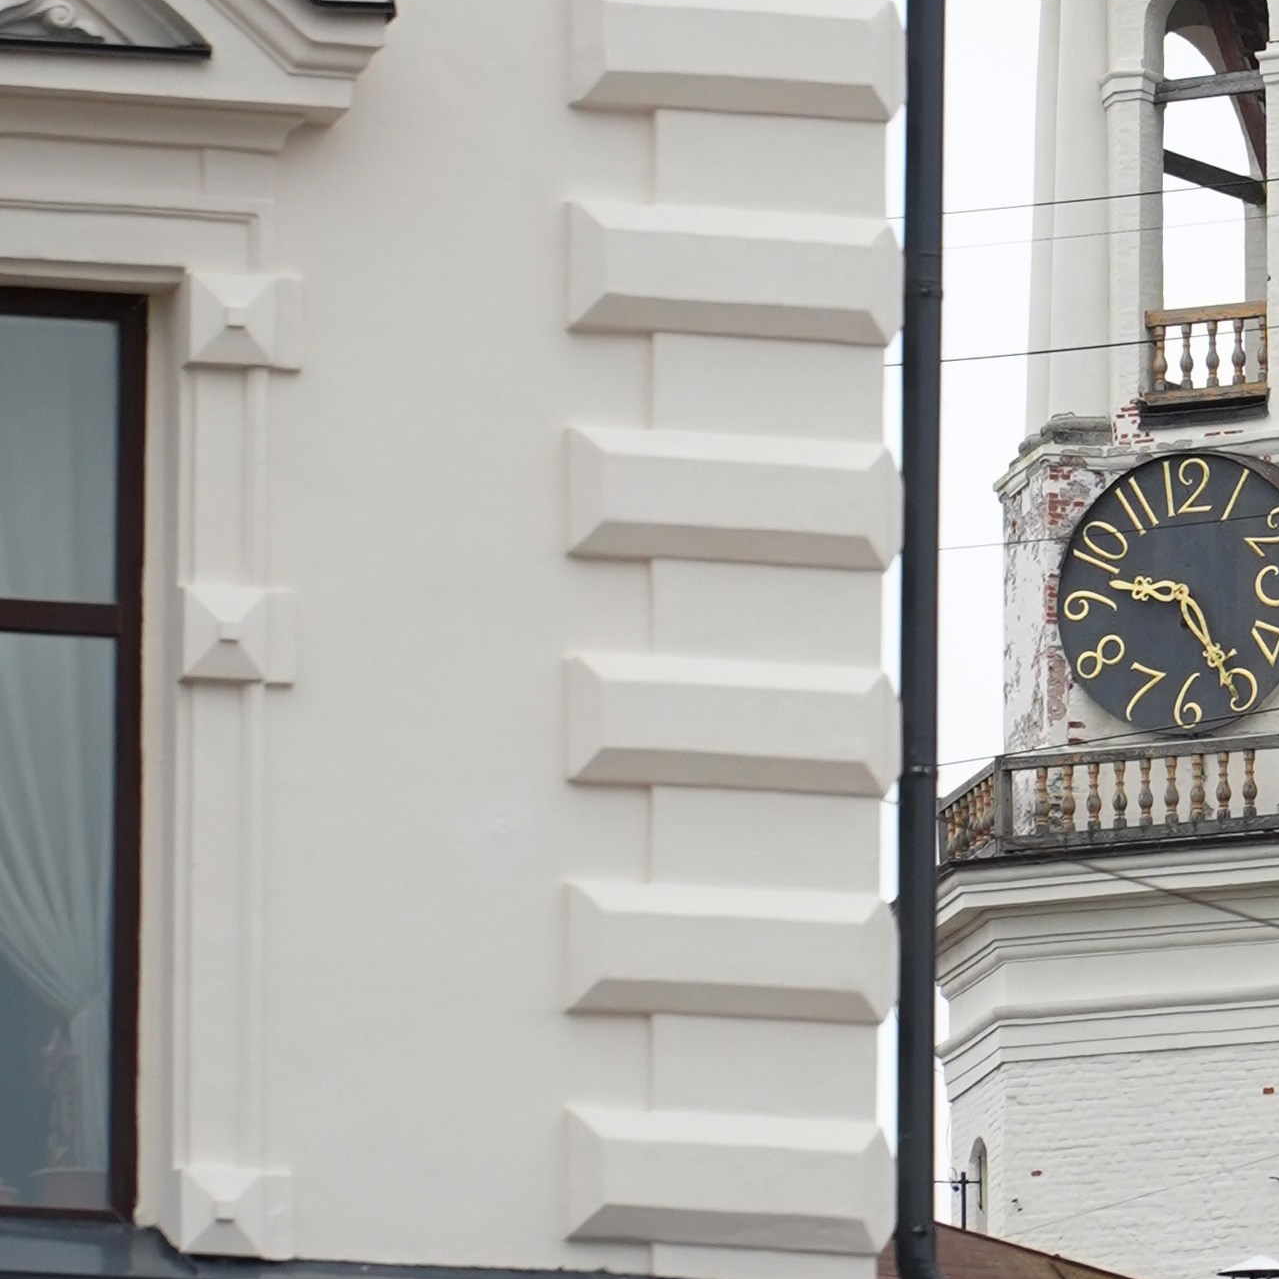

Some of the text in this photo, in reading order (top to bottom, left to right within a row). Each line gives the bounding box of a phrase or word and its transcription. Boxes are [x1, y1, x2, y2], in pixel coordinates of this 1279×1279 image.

[1115, 476, 1159, 536] 11
[1162, 457, 1212, 518] 12
[1220, 468, 1249, 521] 1
[1073, 521, 1128, 574] 10
[1064, 590, 1118, 621] 9
[1076, 634, 1125, 679] 8
[1220, 648, 1258, 712] 5
[1125, 662, 1167, 721] 7
[1173, 672, 1202, 729] 6
